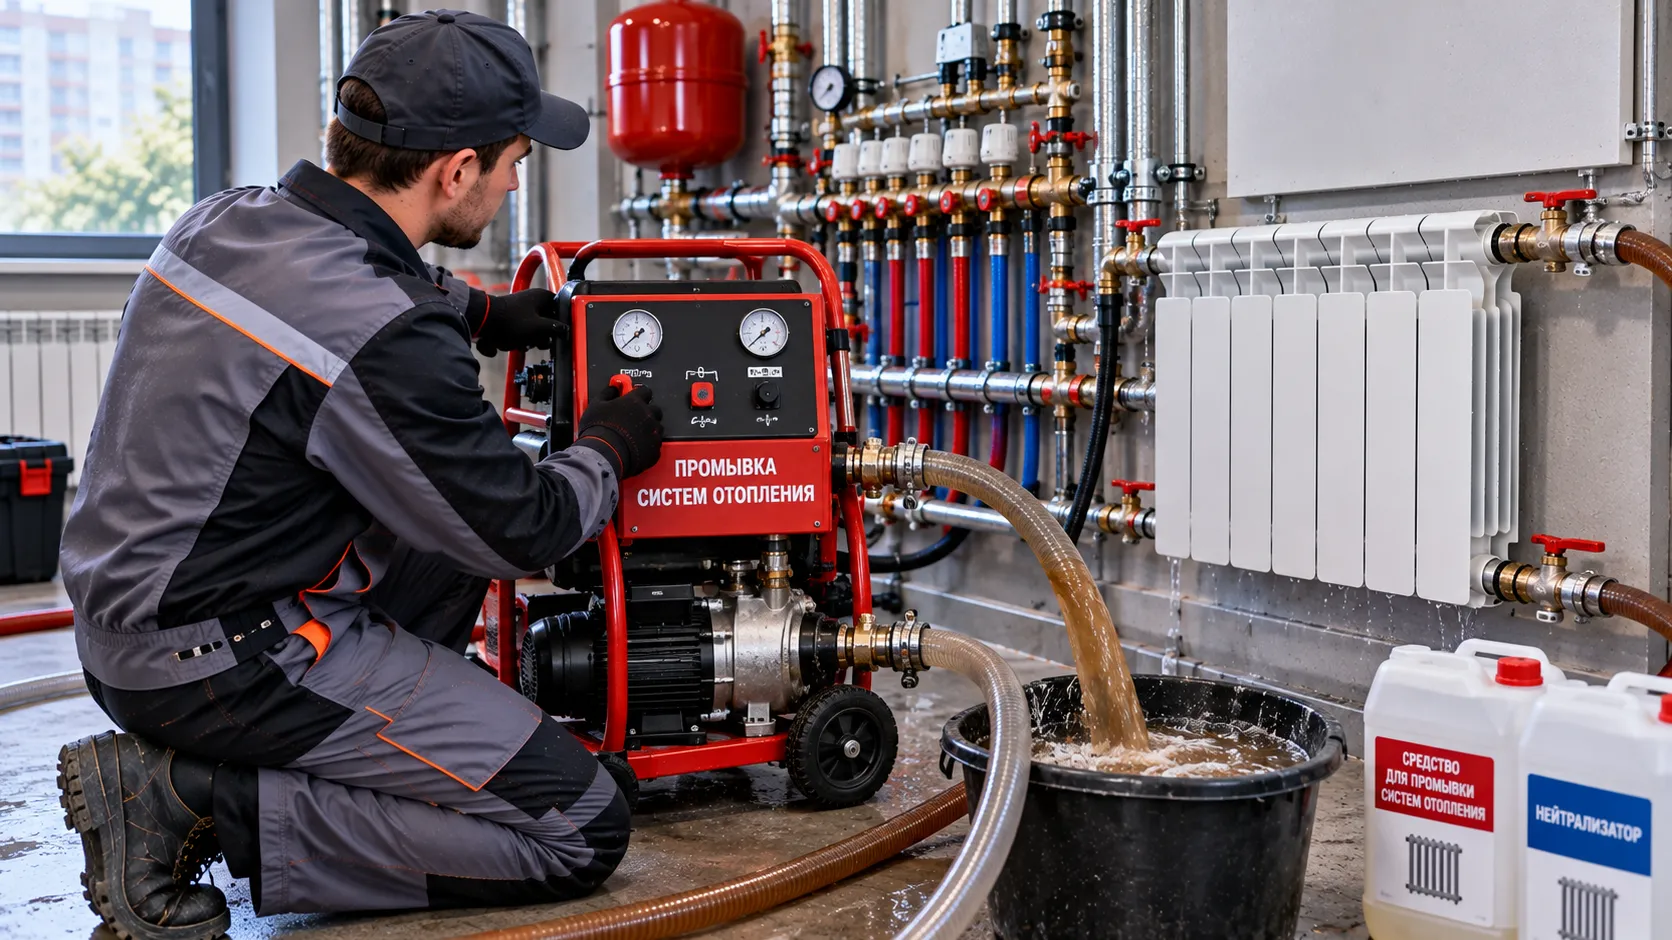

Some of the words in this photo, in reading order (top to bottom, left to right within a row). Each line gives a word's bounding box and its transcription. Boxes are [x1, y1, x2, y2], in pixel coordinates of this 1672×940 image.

[675, 457, 777, 477] ПРОМЫВКА
[637, 488, 707, 506] СИСТЕМ
[713, 485, 815, 505] ОТОПЛЕНИЯ
[1402, 751, 1460, 776] СРЕДСТВО
[1385, 768, 1408, 786] ДЛЯ
[1411, 773, 1475, 799] ПРОМЫВКИ
[1381, 788, 1421, 808] СИСТЕМ
[1424, 796, 1486, 822] ОТОПЛЕНИЯ
[1535, 804, 1643, 844] НЕЙТРАЛИЗАТОР
